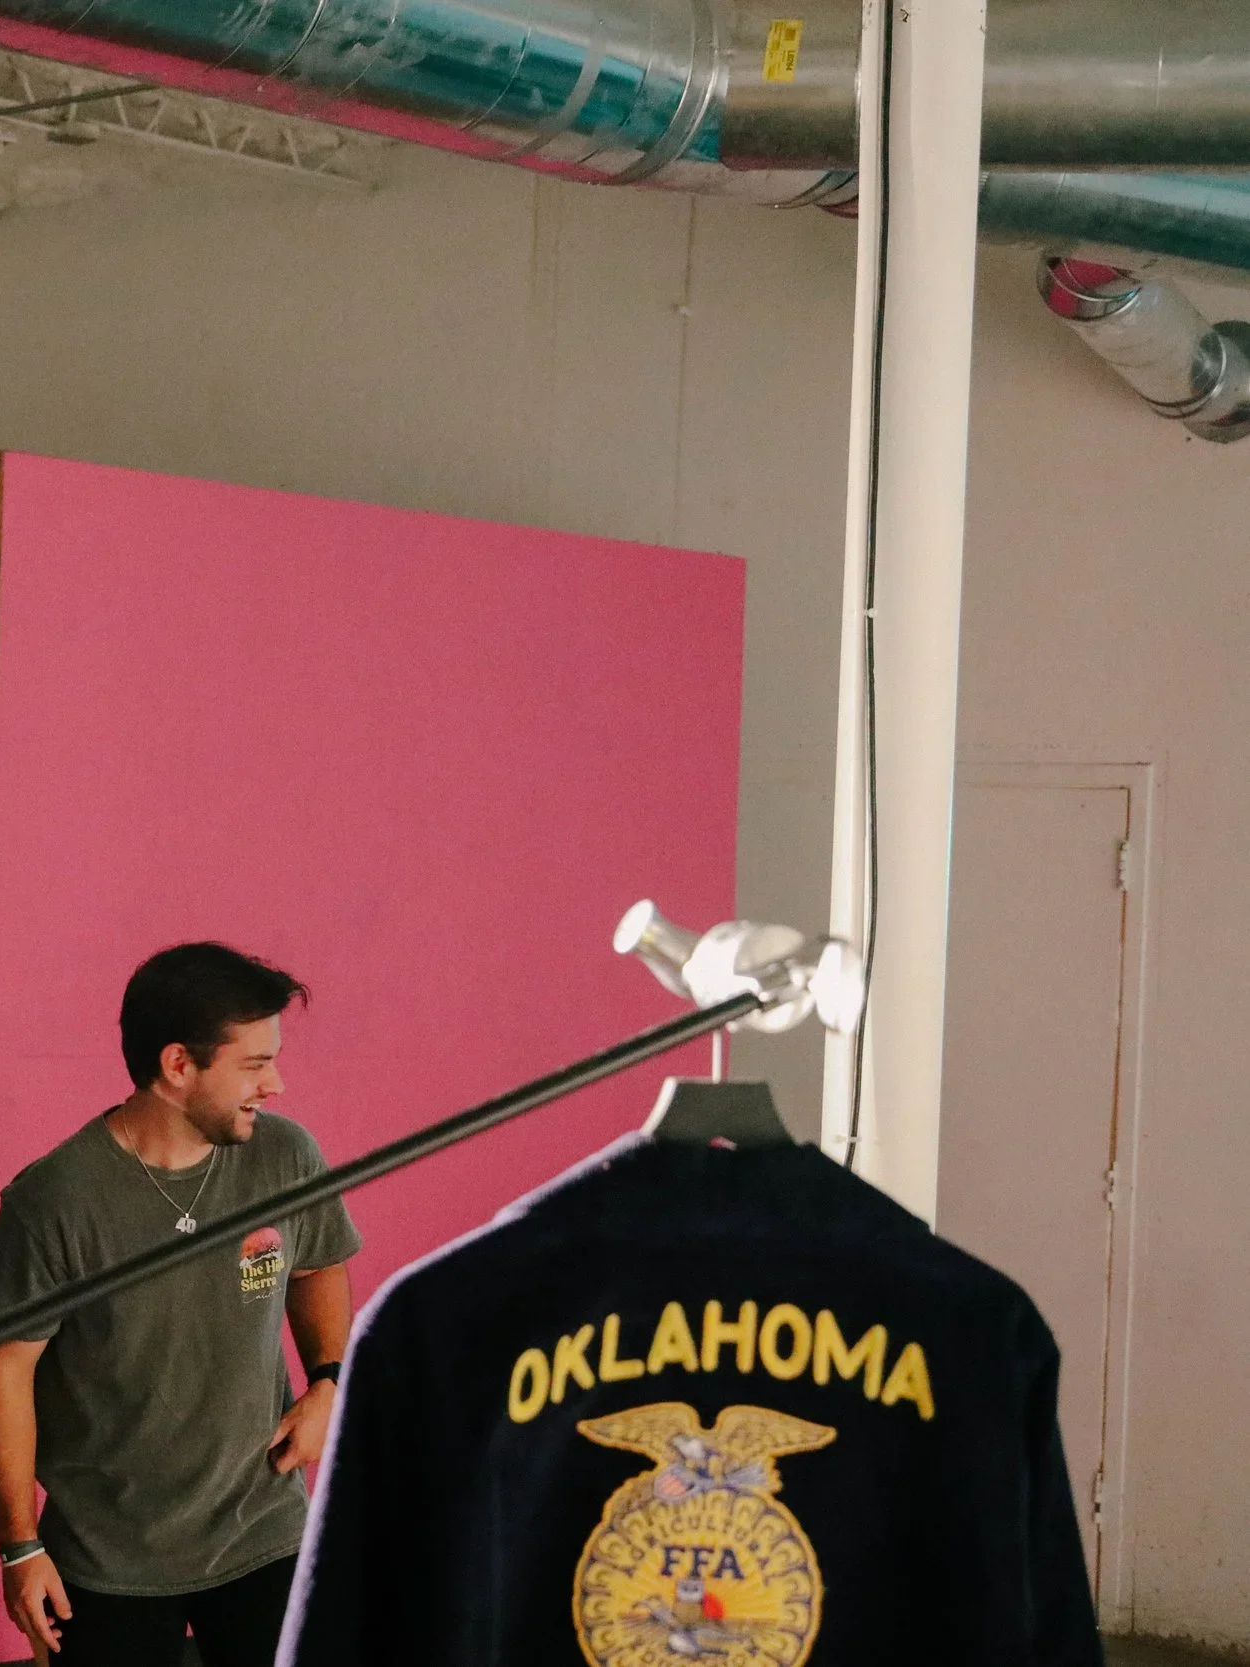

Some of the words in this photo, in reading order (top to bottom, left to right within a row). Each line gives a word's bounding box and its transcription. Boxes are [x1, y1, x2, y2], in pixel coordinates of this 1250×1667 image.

[175, 1217, 196, 1234] 40
[240, 1264, 263, 1278] The
[240, 1277, 277, 1292] Sierra
[508, 1300, 935, 1424] OKLAHOMA
[661, 1545, 745, 1580] FFA
